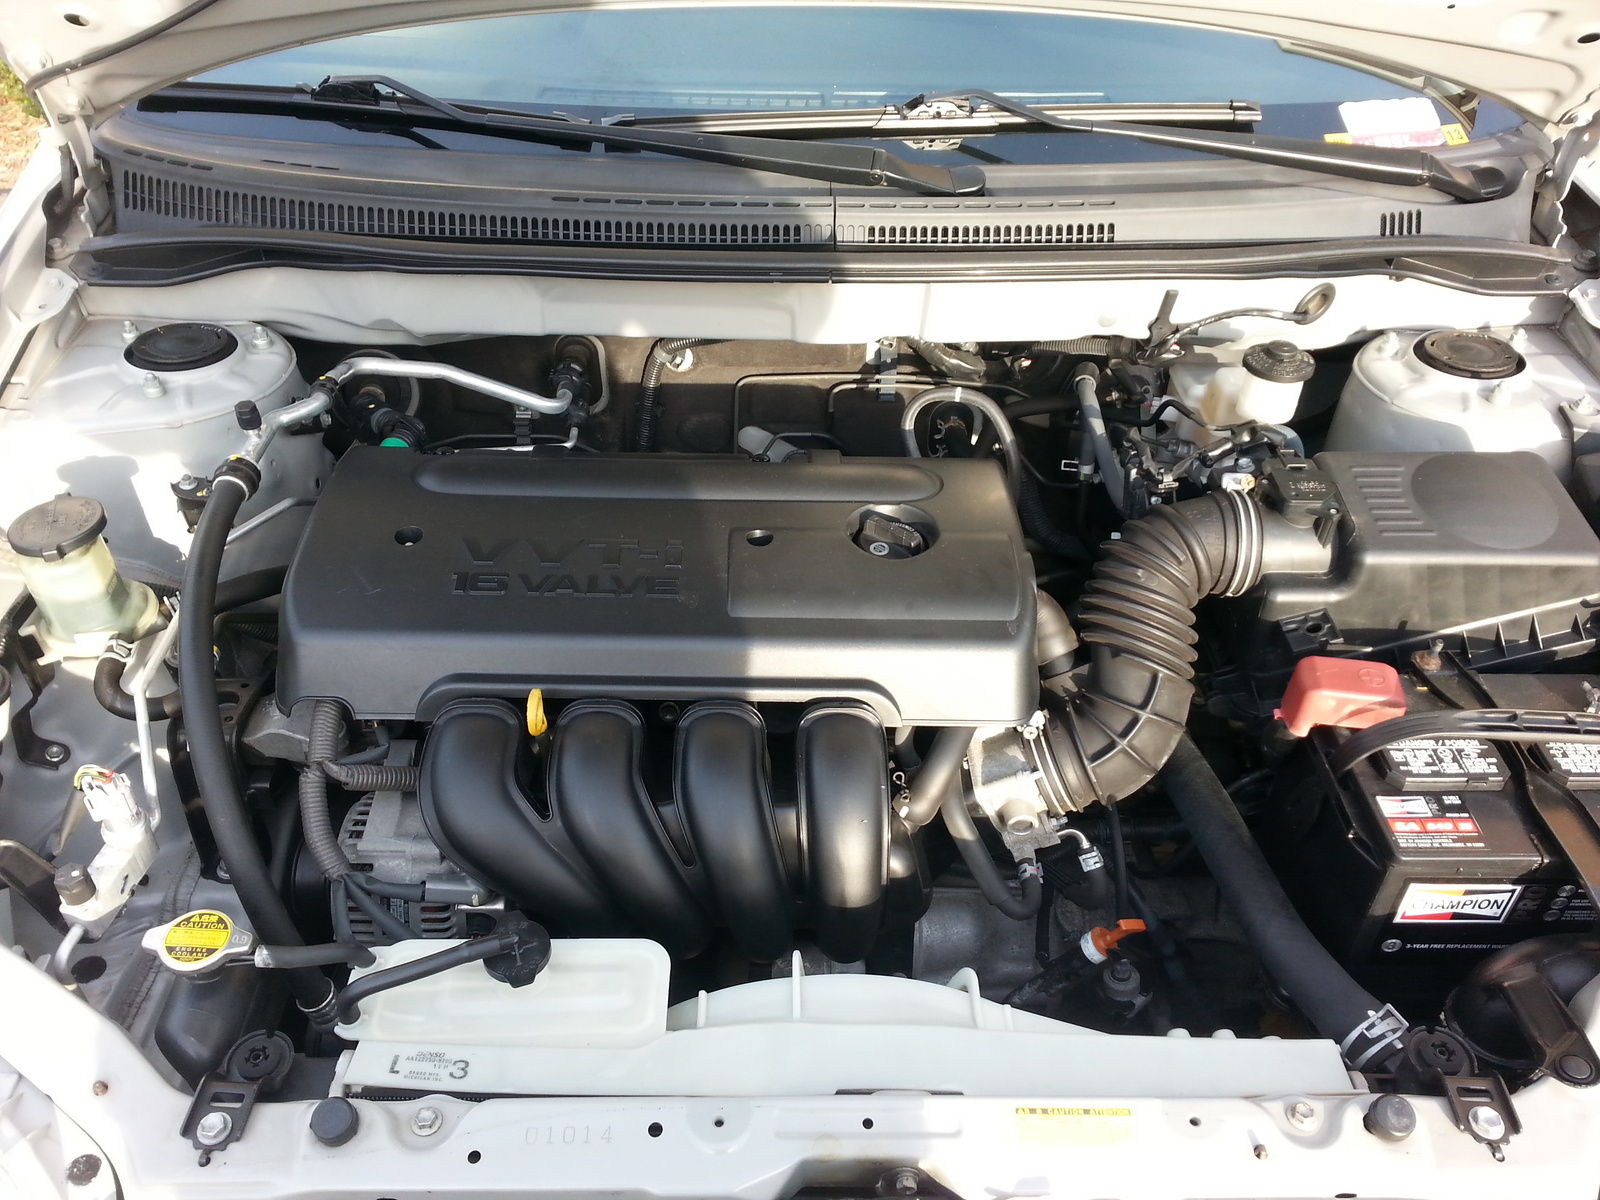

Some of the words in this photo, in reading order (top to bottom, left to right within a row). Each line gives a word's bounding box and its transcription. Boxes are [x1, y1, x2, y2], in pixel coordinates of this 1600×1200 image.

[1446, 128, 1463, 141] 13
[451, 571, 511, 596] 16
[517, 573, 681, 599] VALVE
[179, 921, 225, 929] CAUTION
[231, 935, 248, 944] 0.9
[388, 1054, 401, 1074] L
[448, 1059, 470, 1079] 3
[1089, 1108, 1130, 1116] ATTENTION
[525, 1125, 613, 1145] 01014
